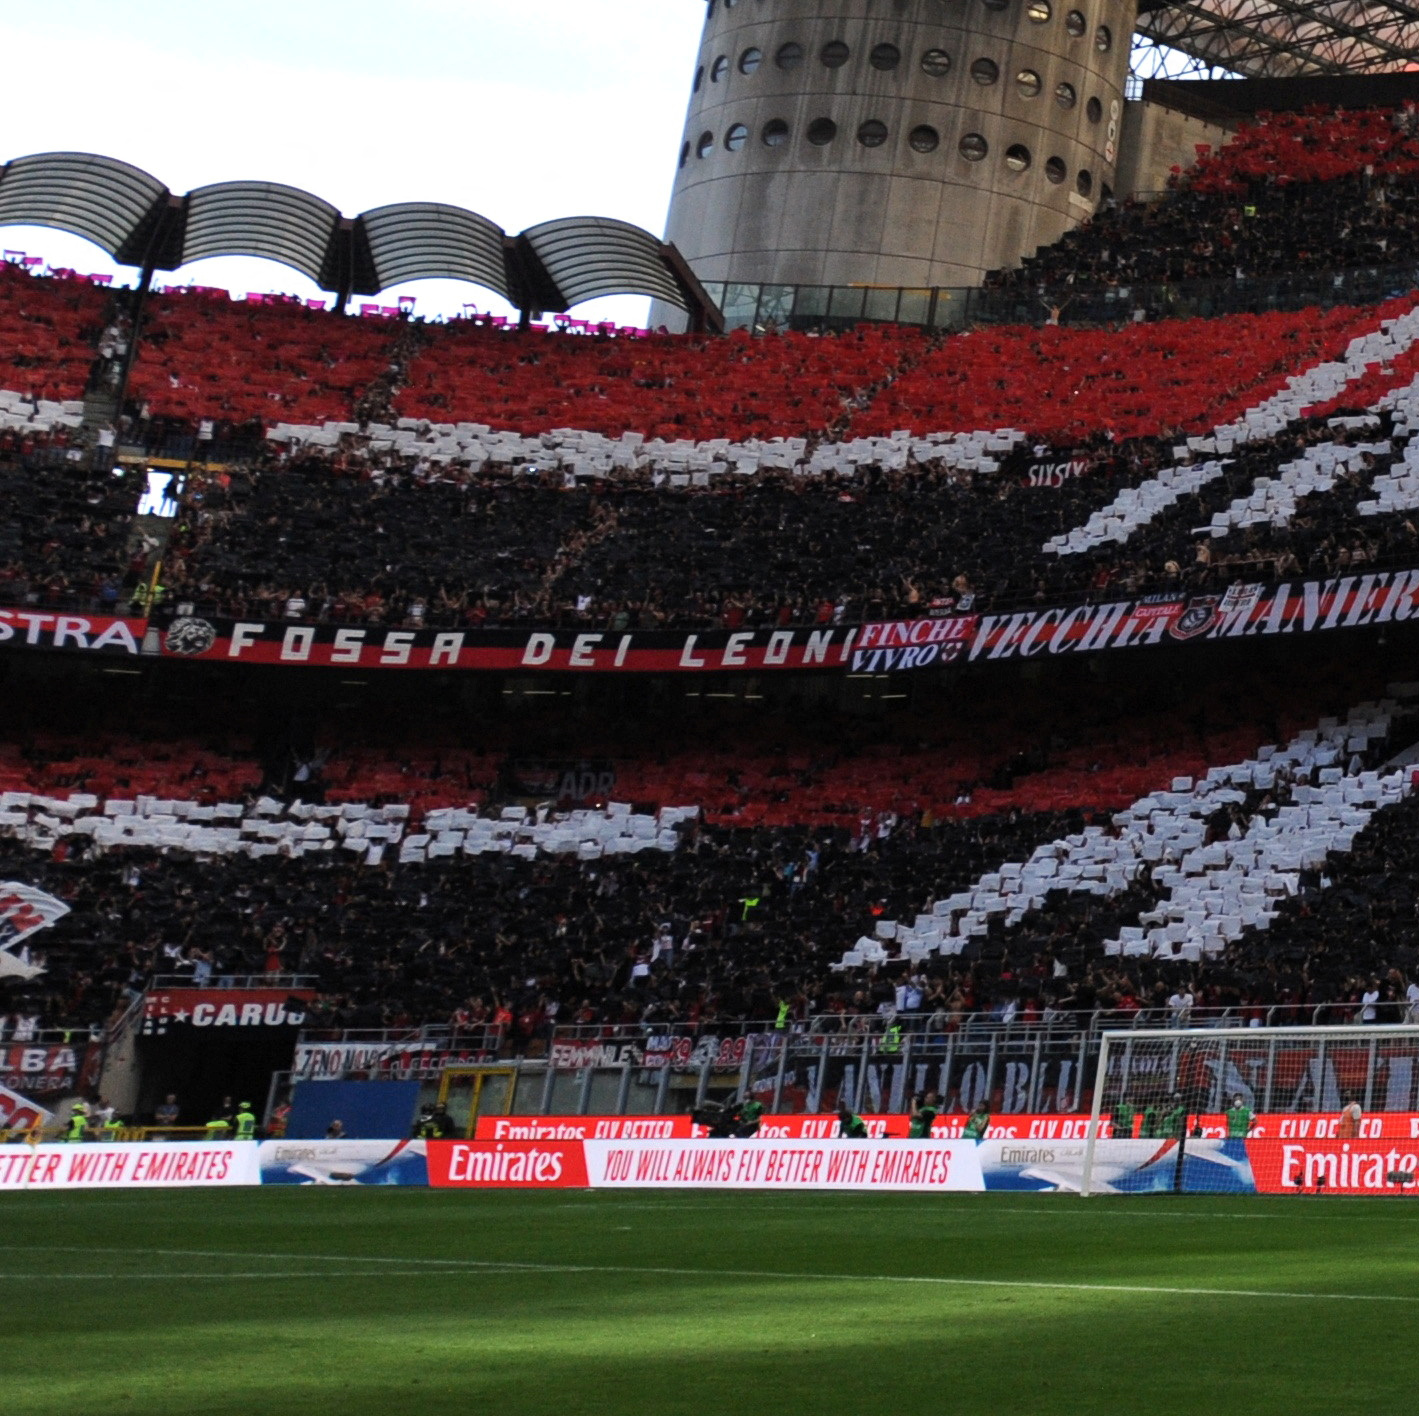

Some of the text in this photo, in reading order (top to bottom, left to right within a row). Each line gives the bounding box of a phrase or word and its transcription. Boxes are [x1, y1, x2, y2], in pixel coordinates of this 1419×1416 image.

[228, 622, 858, 667] FOSSA DEI LEONI
[967, 601, 1170, 662] VECCHIA
[0, 1150, 233, 1183] TTER WITH EMIRATES
[448, 1143, 564, 1182] Emirates
[603, 1150, 952, 1184] YOU WILL ALWAYS FLY BETTER WITH EMIRATES
[1000, 1145, 1056, 1164] Emirates
